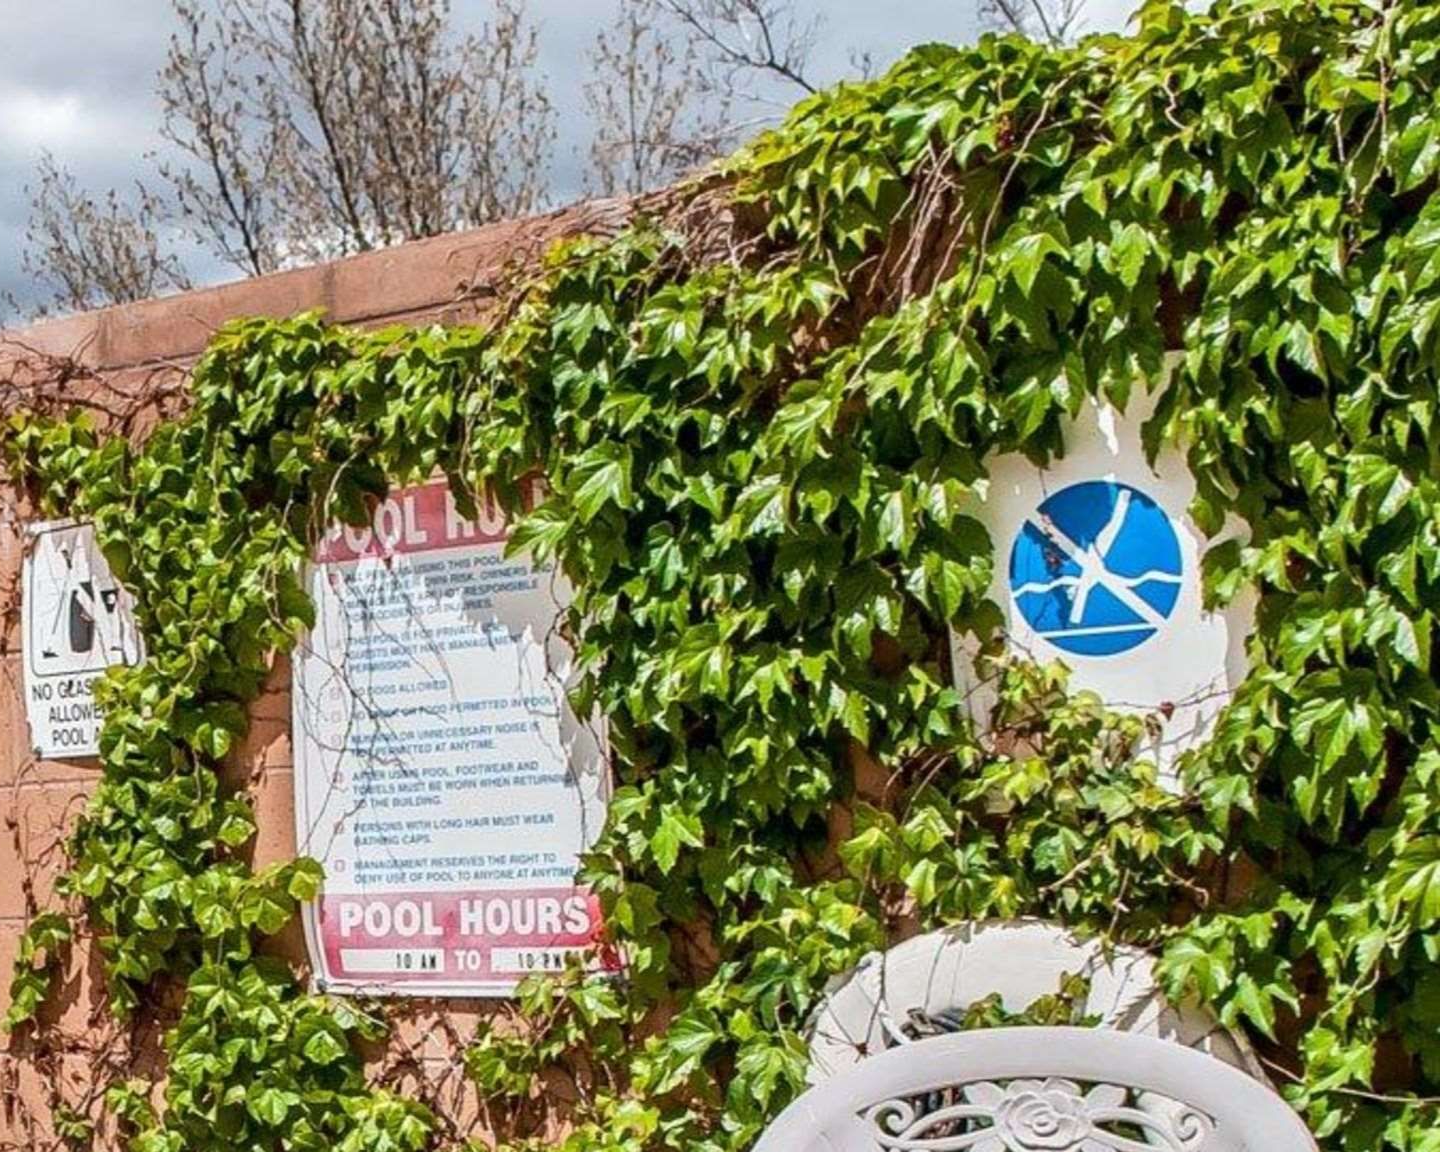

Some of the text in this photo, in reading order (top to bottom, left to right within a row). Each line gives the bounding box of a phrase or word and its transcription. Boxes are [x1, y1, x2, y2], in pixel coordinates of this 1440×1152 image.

[448, 558, 471, 570] THIS
[482, 566, 527, 581] OWNERS
[463, 579, 538, 597] RESPONSIBLE
[32, 678, 94, 702] NO GLAS
[48, 703, 104, 723] ALLOWE
[450, 698, 509, 714] PERMITTED
[52, 726, 88, 747] POOL
[417, 724, 493, 741] UNNECESSARY
[496, 721, 528, 734] NOISE
[456, 762, 515, 775] FOOTWEAR
[517, 761, 538, 771] AND
[398, 782, 425, 793] MUST
[427, 781, 442, 791] BE
[445, 777, 478, 791] WORN
[479, 777, 511, 789] WHEN
[370, 797, 389, 808] THE
[354, 812, 554, 833] PERSONS WITH LONG HAIR MUST WEAR
[430, 856, 485, 868] RESERVES
[487, 854, 507, 865] THE
[509, 852, 539, 865] RIGHT
[542, 852, 557, 863] TO
[354, 873, 383, 884] DENY
[385, 871, 407, 884] USE
[409, 871, 424, 882] OF
[426, 870, 455, 883] POOL
[458, 870, 471, 881] TO
[473, 868, 514, 881] ANYONE
[516, 867, 529, 878] AT
[339, 896, 591, 938] POOL HOURS
[396, 952, 411, 970] 10
[420, 952, 437, 970] AM
[453, 949, 481, 971] TO
